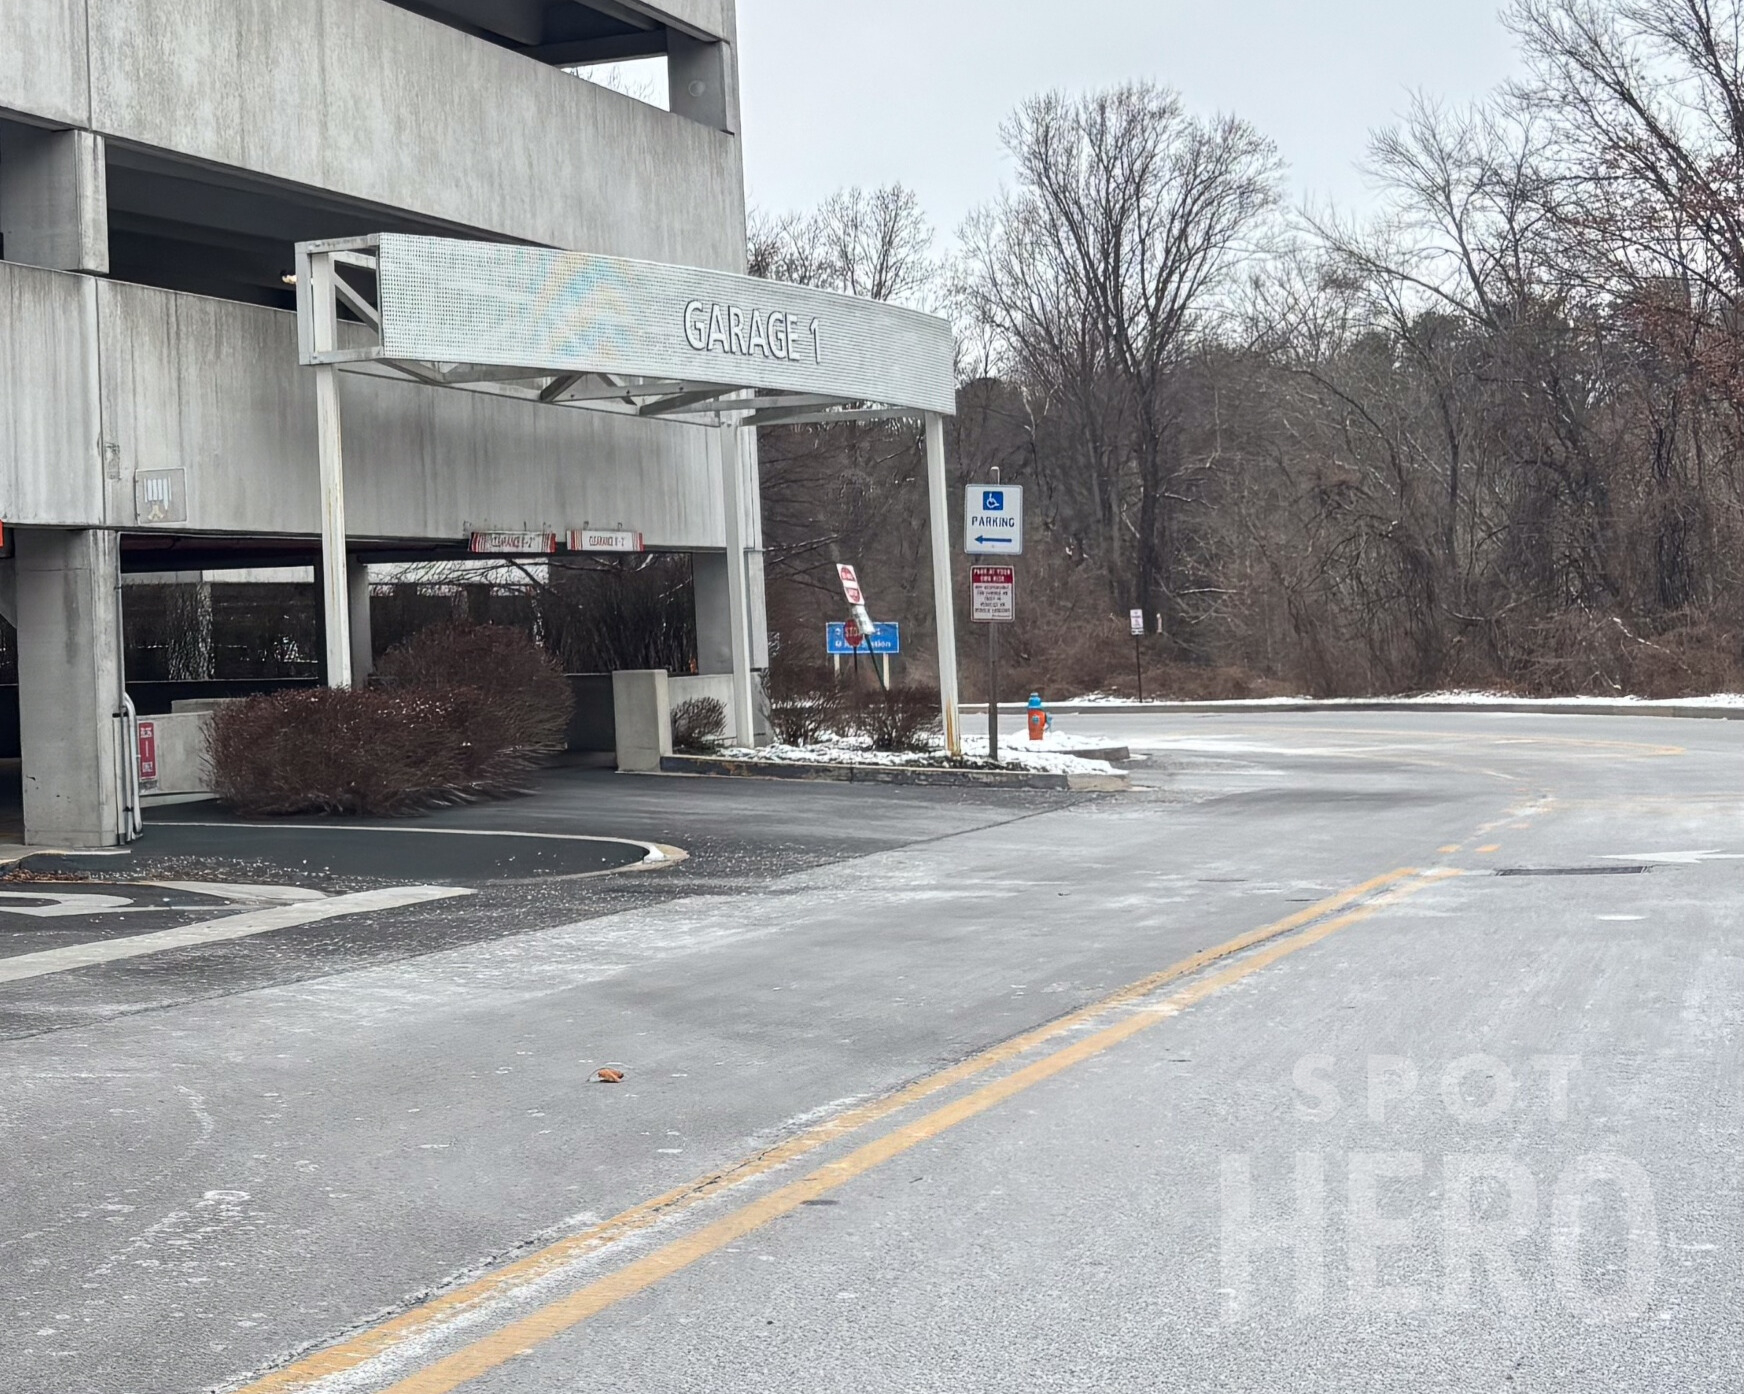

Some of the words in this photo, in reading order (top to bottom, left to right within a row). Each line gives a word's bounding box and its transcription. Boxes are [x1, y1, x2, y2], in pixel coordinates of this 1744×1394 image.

[684, 299, 800, 362] GARAGE
[809, 316, 821, 365] 1
[971, 516, 1015, 528] PARKING
